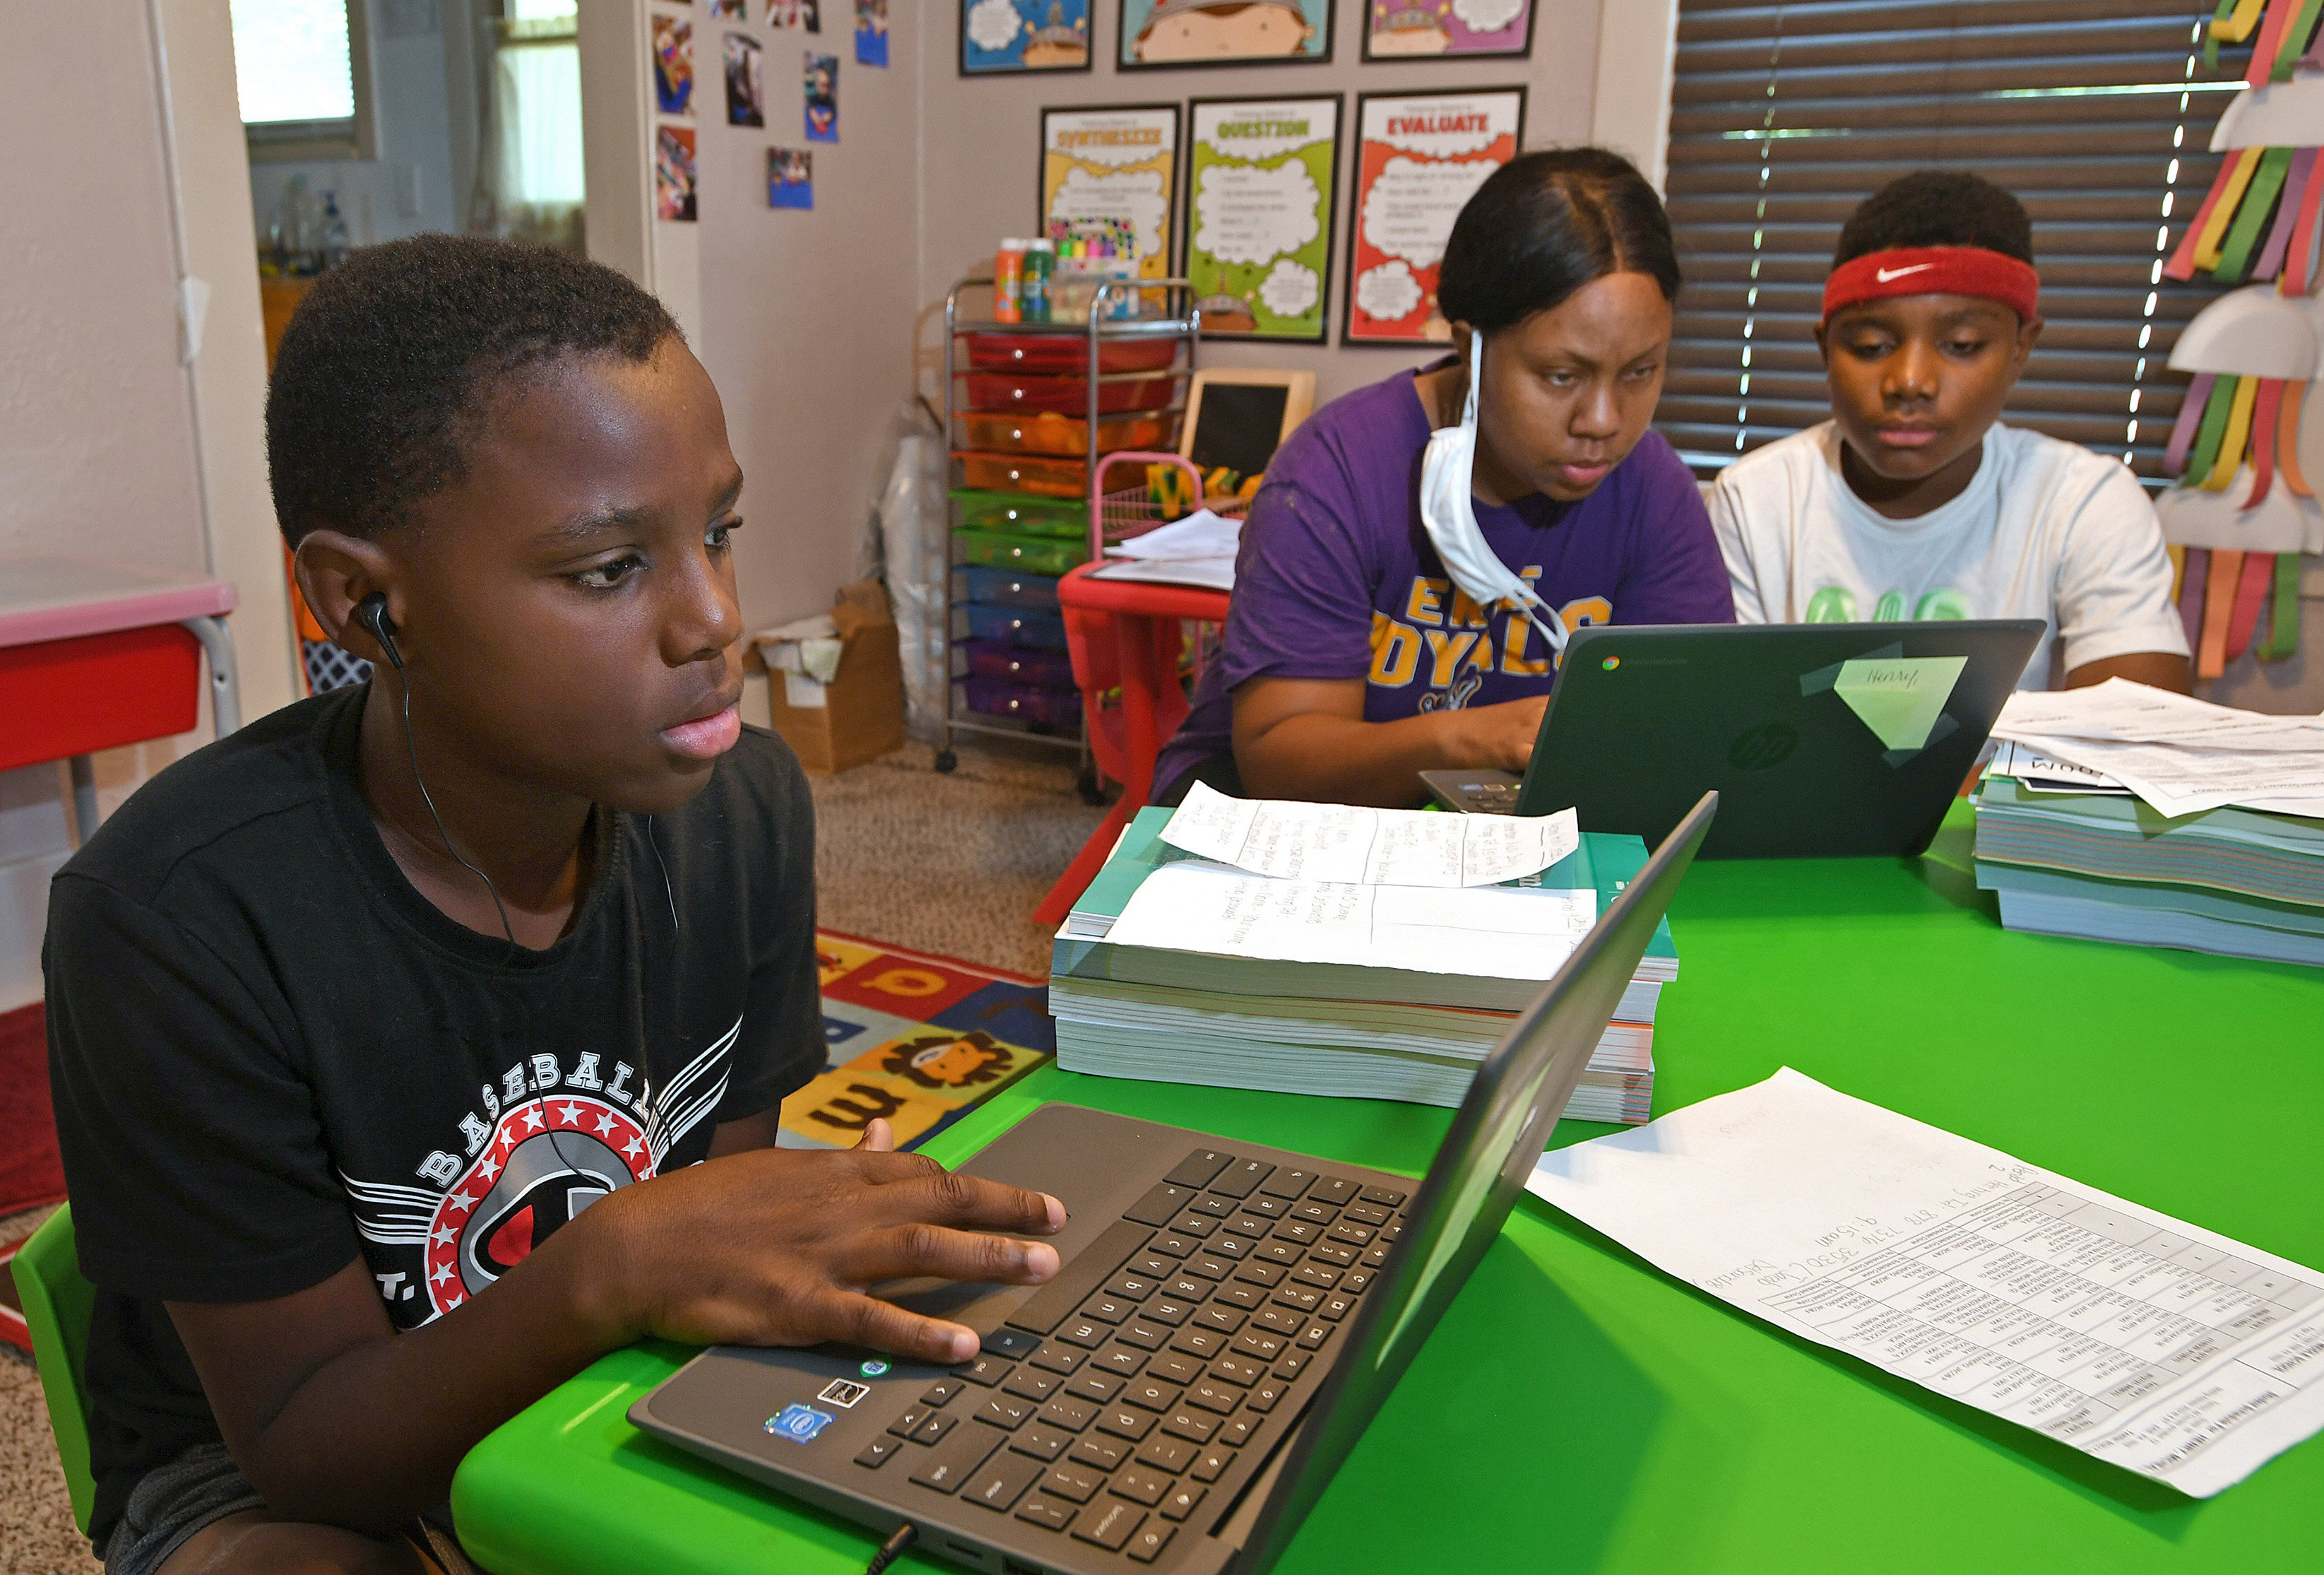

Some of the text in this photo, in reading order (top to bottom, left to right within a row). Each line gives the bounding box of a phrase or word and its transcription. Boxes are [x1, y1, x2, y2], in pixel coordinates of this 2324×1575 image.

[1217, 119, 1310, 139] QUESTION
[1387, 113, 1489, 136] EVALUATE
[1904, 1210, 1938, 1226] 878
